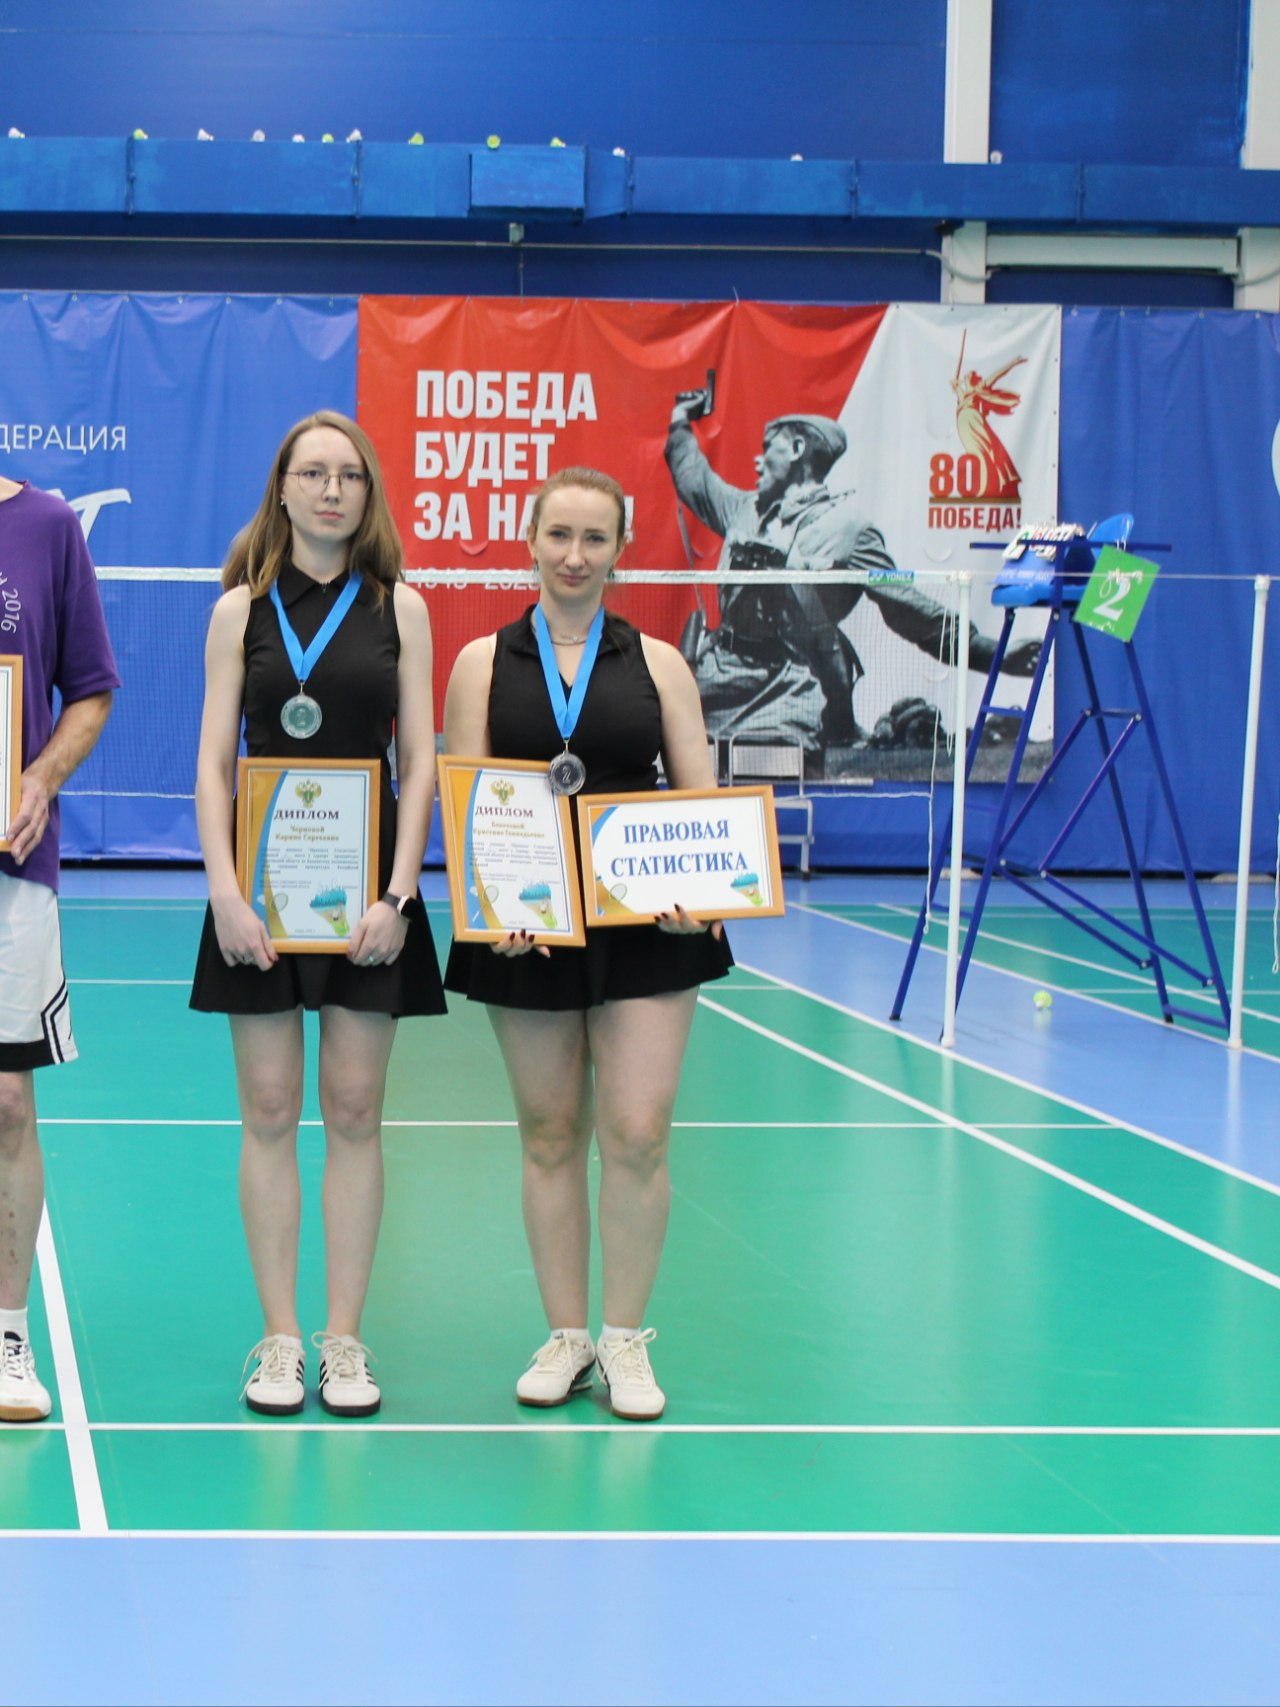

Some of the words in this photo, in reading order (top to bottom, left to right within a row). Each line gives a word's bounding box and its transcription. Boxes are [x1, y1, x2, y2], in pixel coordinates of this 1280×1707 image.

[416, 370, 597, 428] ПОБЕДА
[415, 431, 555, 488] БУДЕТ
[929, 453, 981, 497] 80
[414, 492, 472, 540] ЗА
[928, 507, 1022, 533] ПОБЕДА!
[1, 588, 21, 633] 2016
[1093, 573, 1132, 621] 2
[274, 809, 340, 820] ДИПЛОМ
[475, 805, 534, 818] ДИПЛОМ
[624, 819, 730, 844] ПРАВОВАЯ
[611, 851, 748, 877] СТАТИСТИКА
